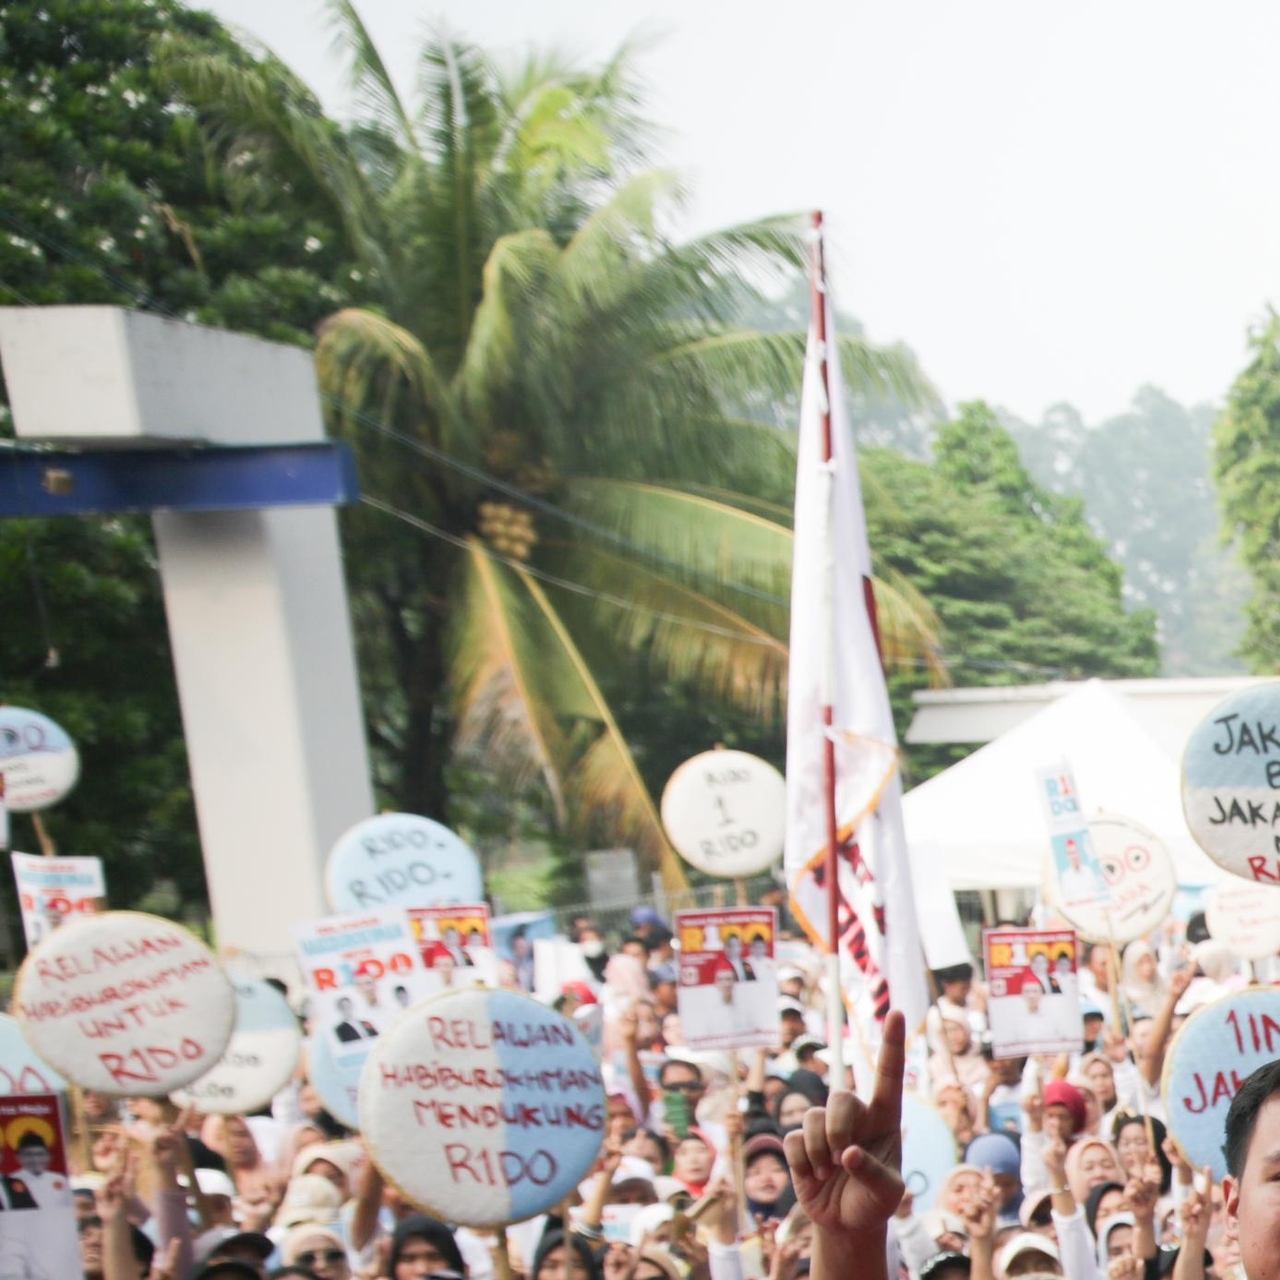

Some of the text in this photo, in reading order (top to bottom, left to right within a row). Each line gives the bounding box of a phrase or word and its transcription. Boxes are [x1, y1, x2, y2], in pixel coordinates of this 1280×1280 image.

[700, 828, 761, 861] RIDO
[37, 932, 183, 989] RELAWAN
[78, 996, 187, 1041] UNTUK
[426, 1015, 577, 1052] RELAWAN
[380, 1057, 603, 1094] HABIBUROKHMAN
[413, 1098, 604, 1133] MENDUKUNG
